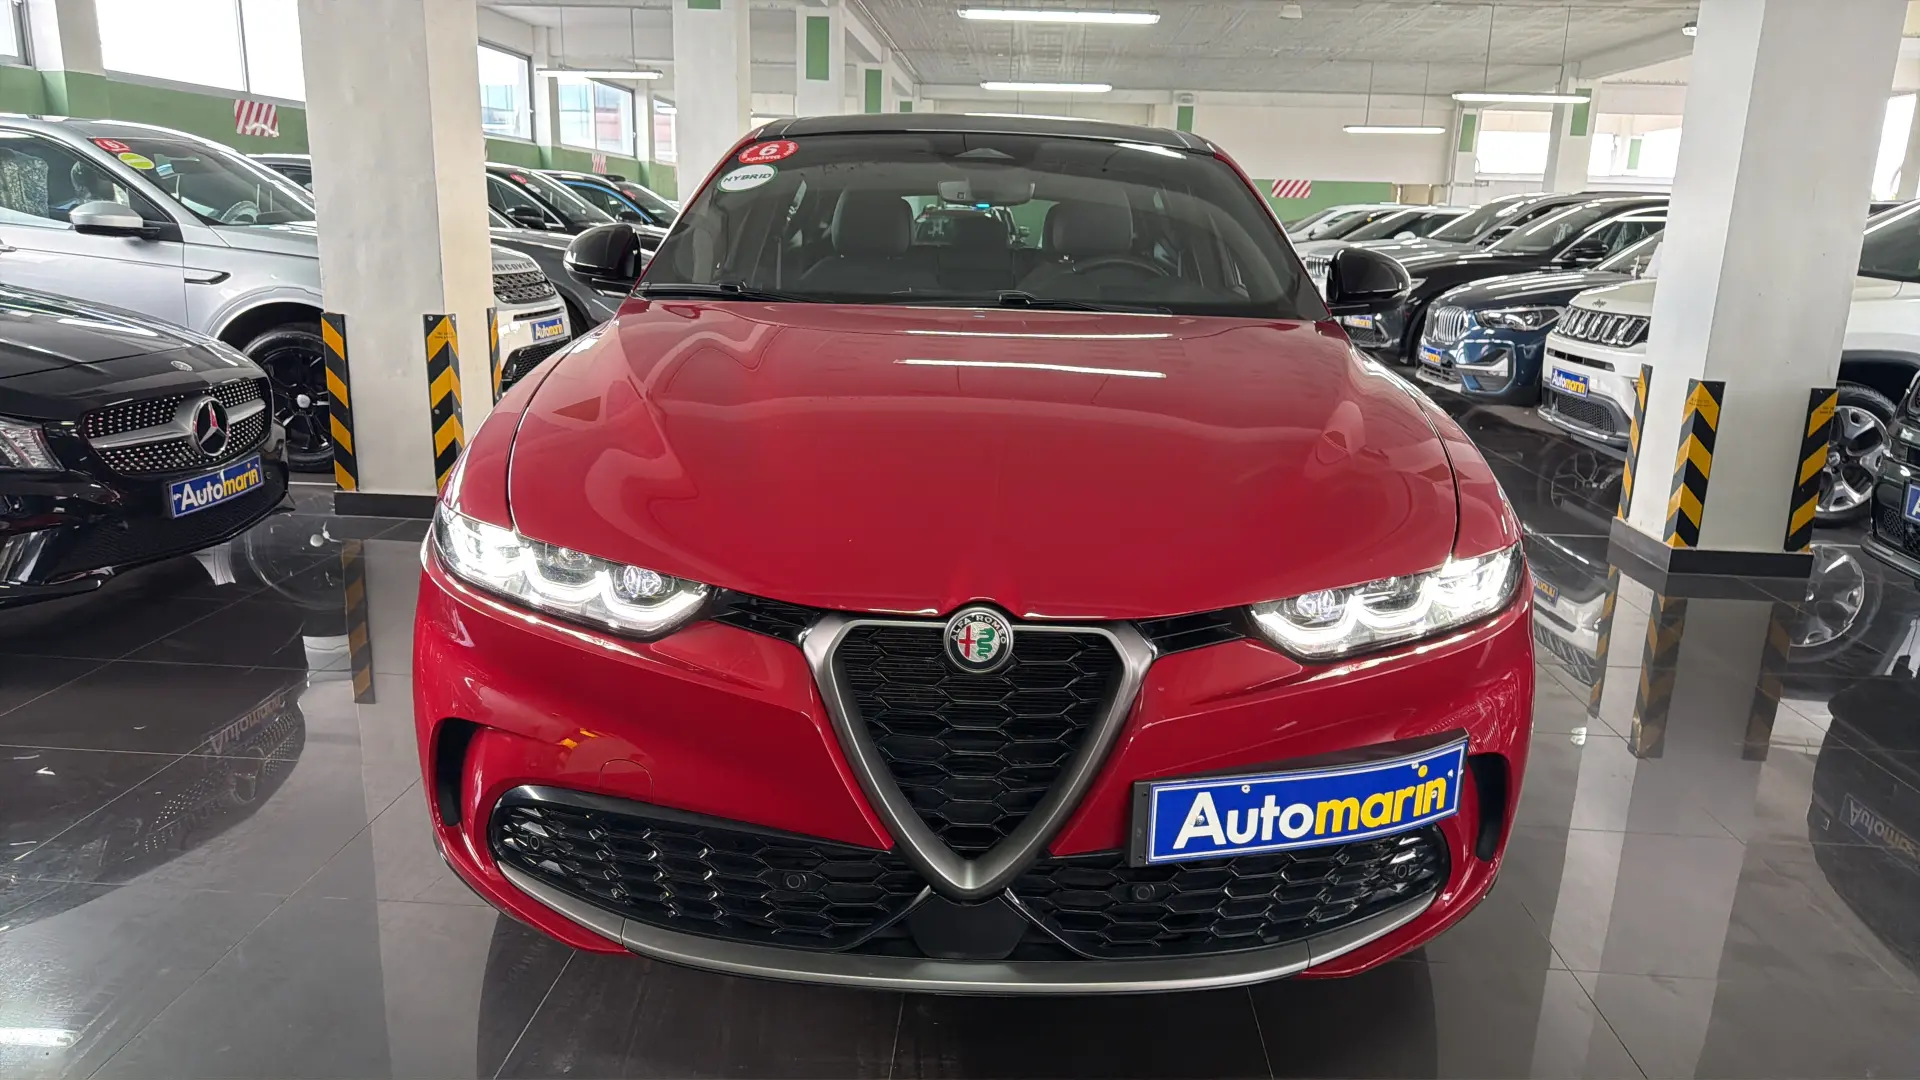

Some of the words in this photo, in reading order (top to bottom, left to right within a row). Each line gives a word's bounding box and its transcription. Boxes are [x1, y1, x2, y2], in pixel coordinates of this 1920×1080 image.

[759, 143, 780, 156] 6
[723, 172, 772, 183] HYBRID
[1551, 369, 1586, 394] Automarin
[180, 462, 260, 511] Automarin
[951, 617, 972, 641] ALFA
[975, 614, 1007, 644] ROMEO
[1173, 764, 1447, 850] Automarin
